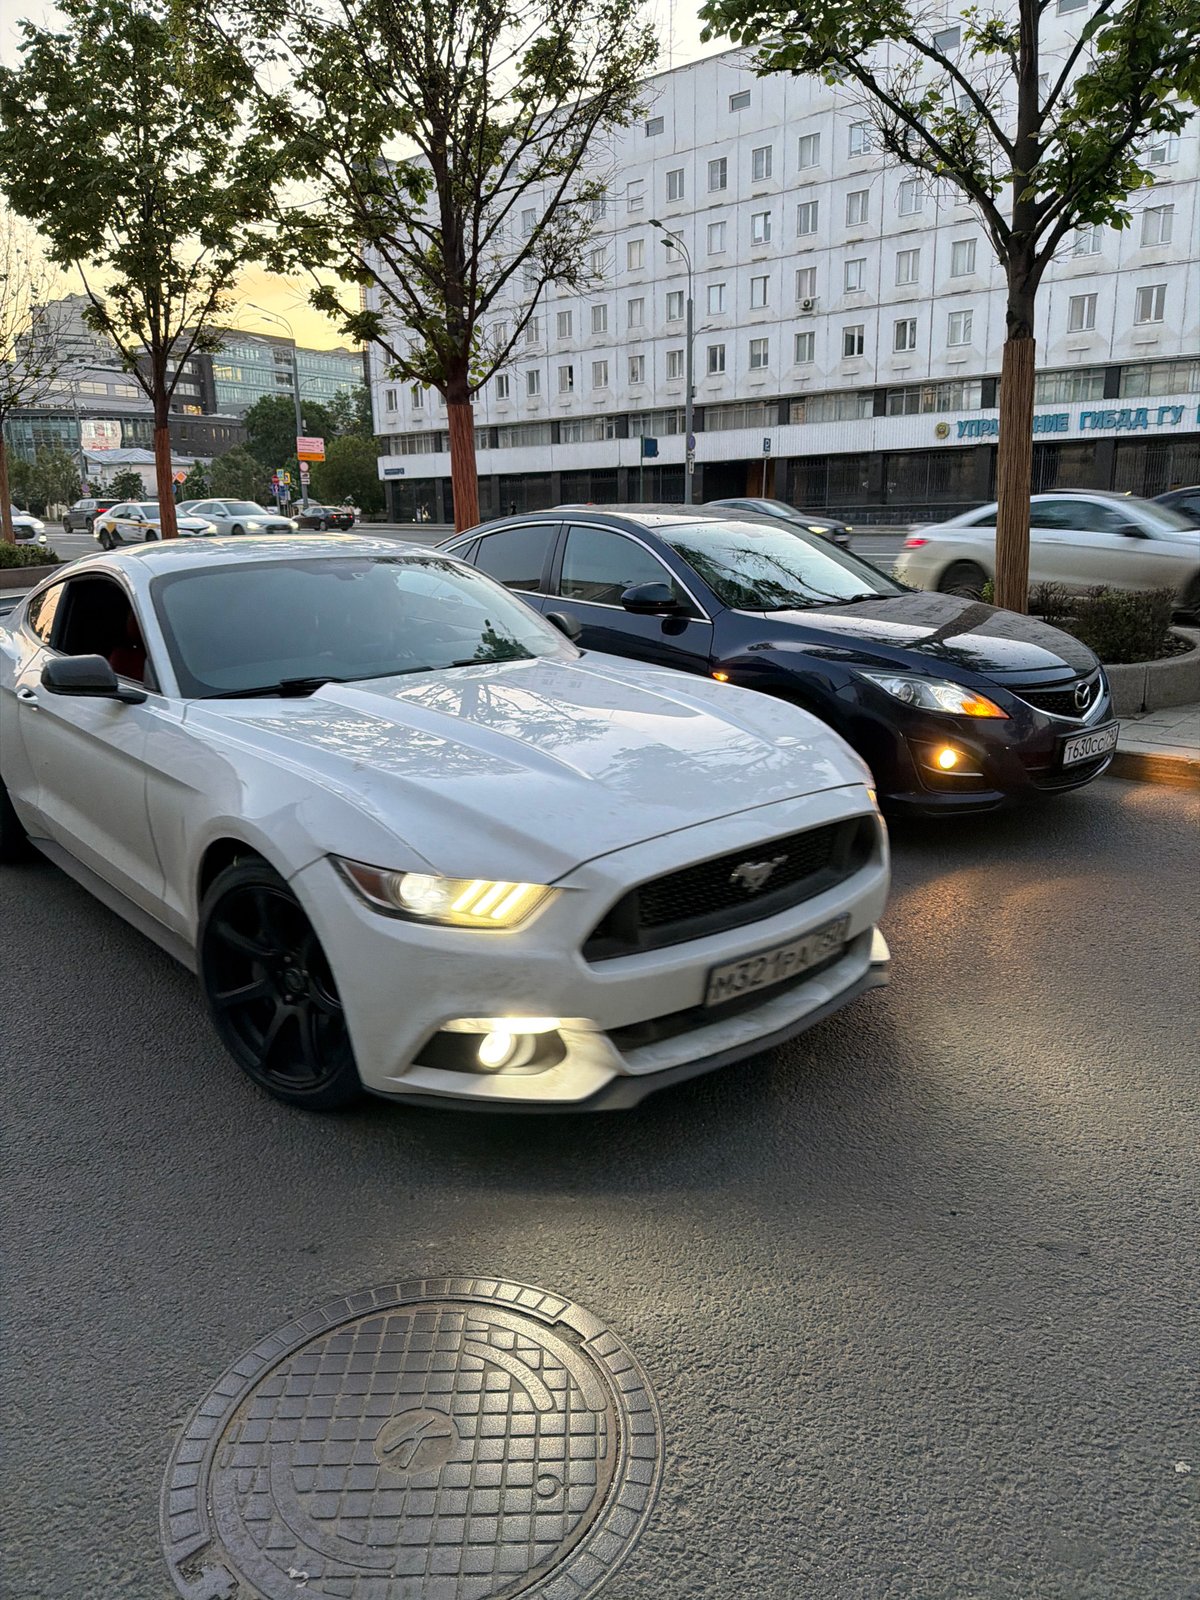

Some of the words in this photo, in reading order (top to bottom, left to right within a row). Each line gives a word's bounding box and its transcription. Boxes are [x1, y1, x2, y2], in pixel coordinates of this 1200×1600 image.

[957, 413, 1069, 438] УПРАНИЕ
[1079, 407, 1148, 431] ГИБДД
[1157, 405, 1185, 426] ГУ
